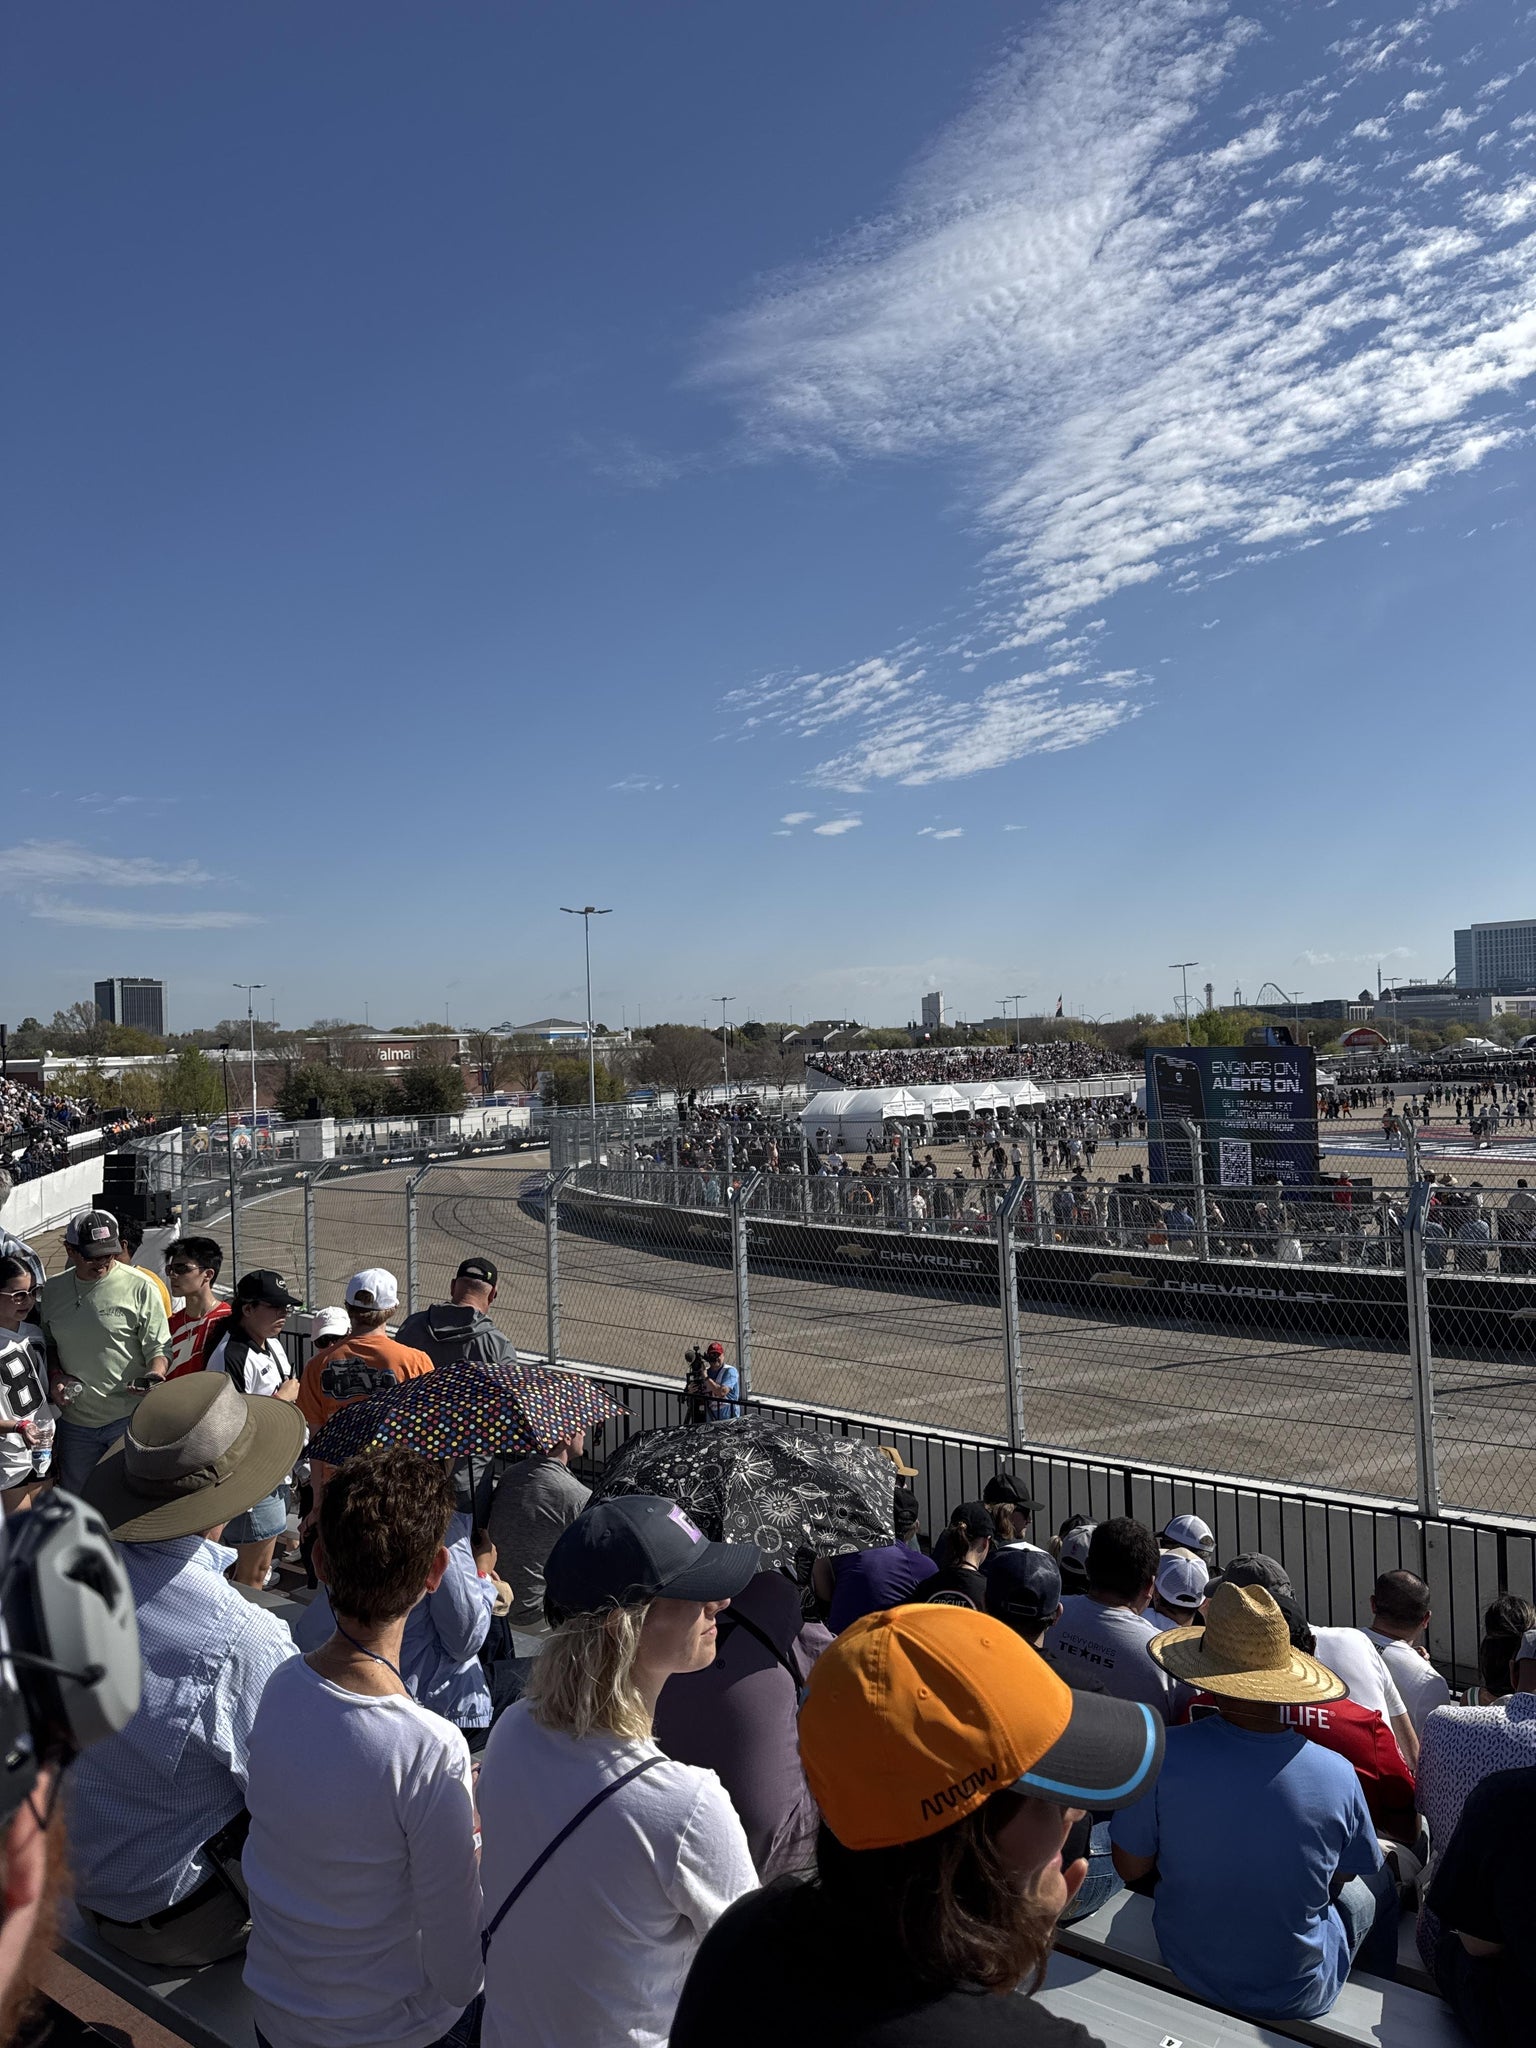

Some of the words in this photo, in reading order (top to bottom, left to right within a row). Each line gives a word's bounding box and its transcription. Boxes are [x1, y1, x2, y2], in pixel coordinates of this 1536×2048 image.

[1211, 1061, 1272, 1076] ENGINES
[1212, 1077, 1272, 1093] ALERTS
[1273, 1079, 1304, 1094] ON.
[712, 1230, 772, 1246] CHEOLET
[880, 1250, 983, 1270] CHEVROLET
[1164, 1280, 1336, 1304] CHEVROLET
